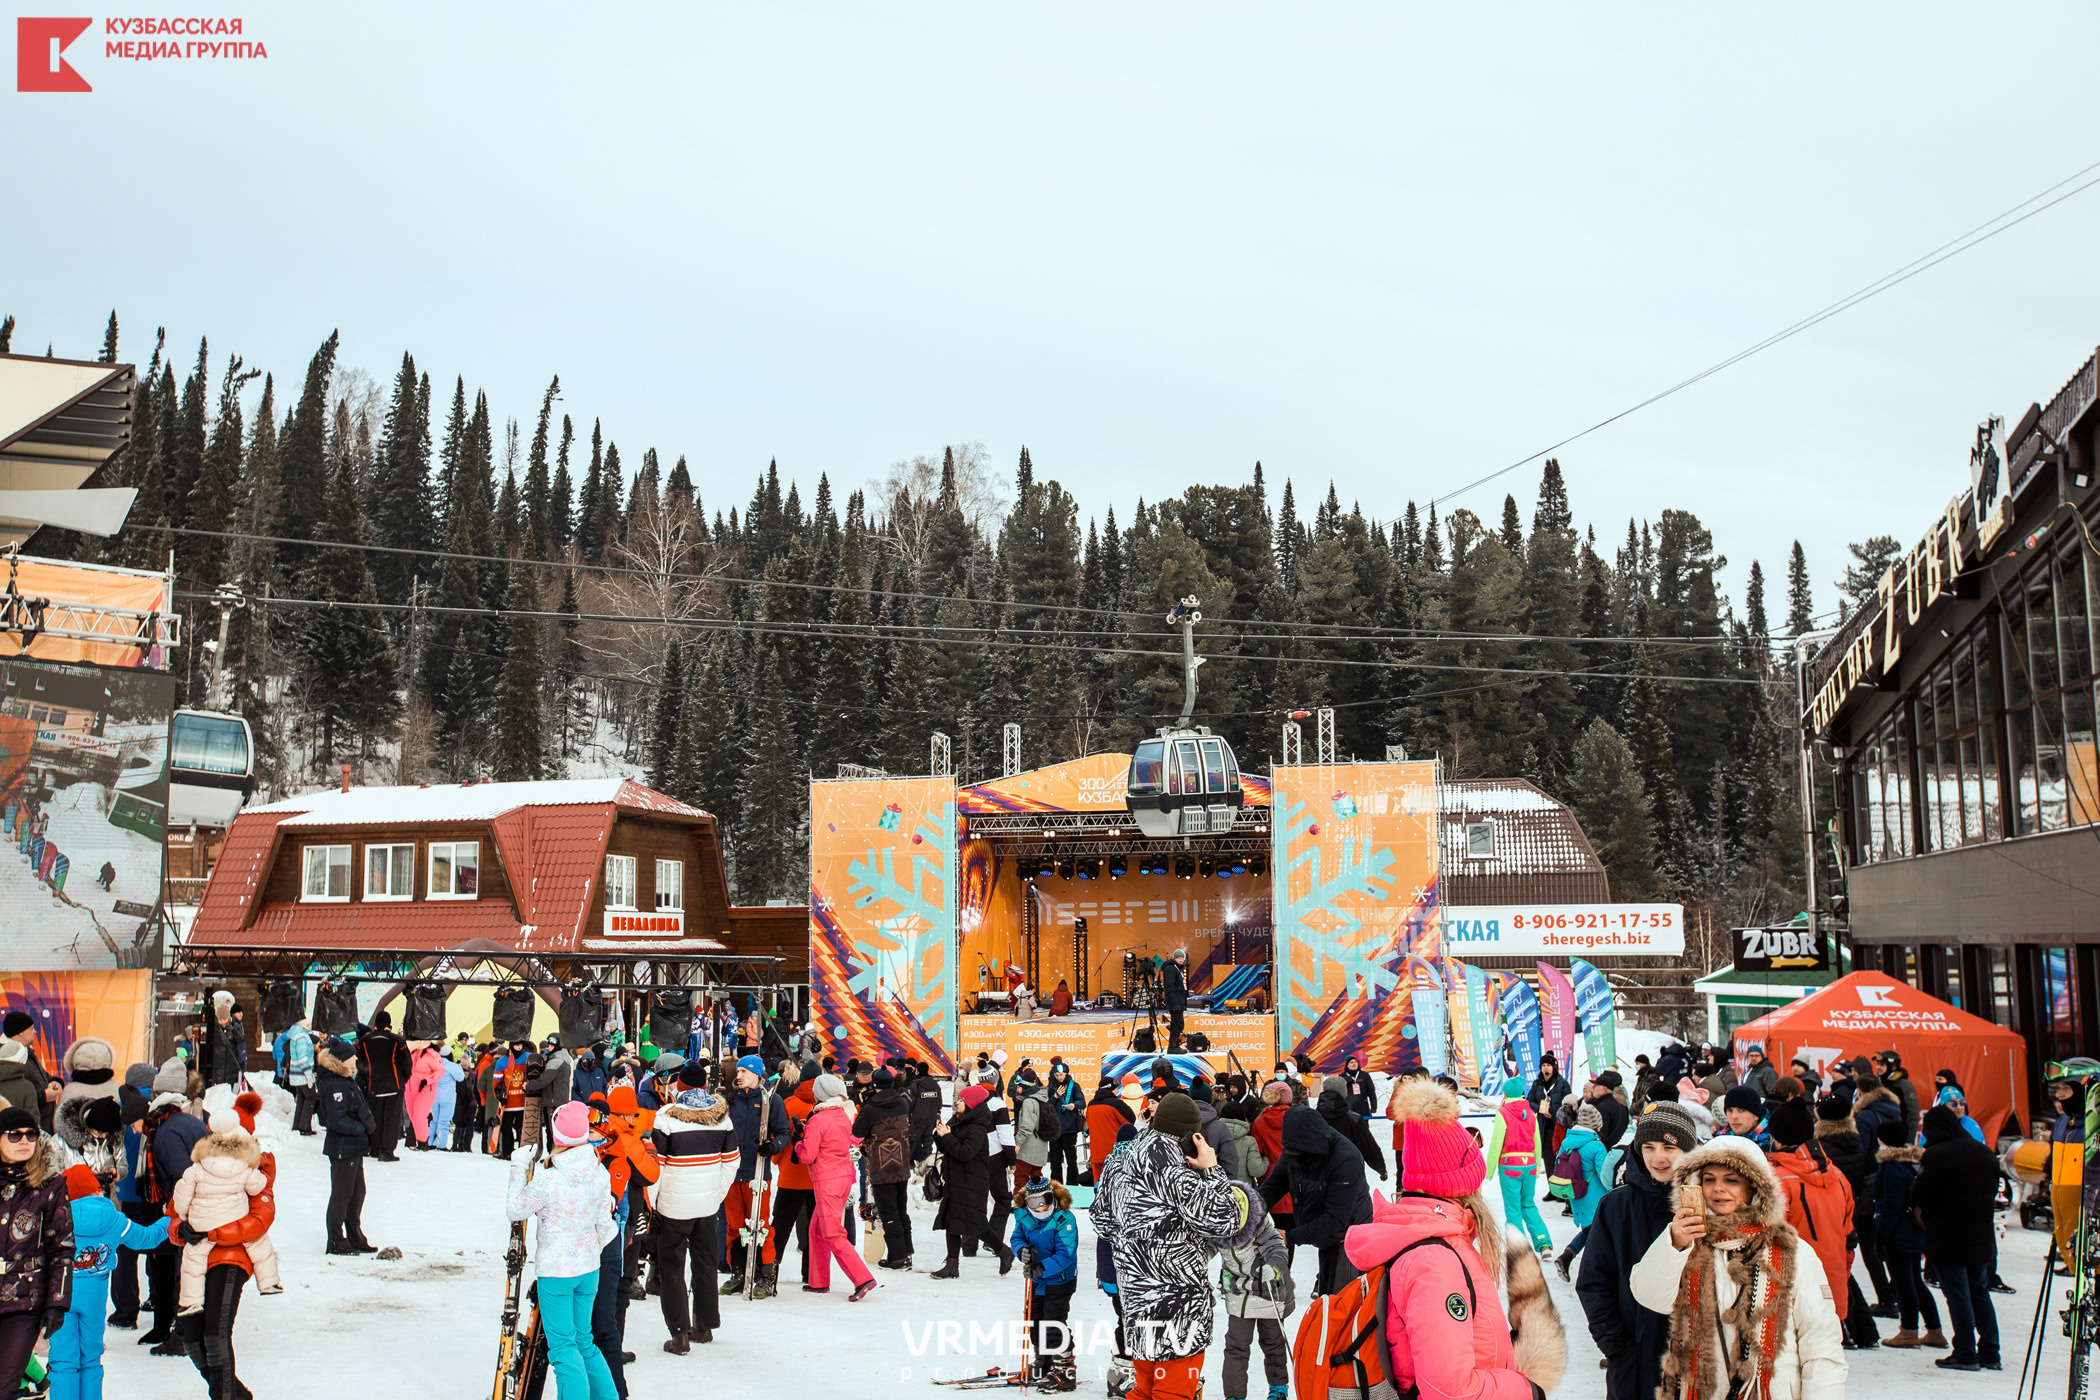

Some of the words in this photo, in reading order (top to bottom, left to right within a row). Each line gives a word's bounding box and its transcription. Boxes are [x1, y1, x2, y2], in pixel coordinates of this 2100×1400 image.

[1812, 660, 1847, 735] GRILL
[1847, 628, 1873, 691] BAR
[1878, 495, 1964, 676] ZUBR
[1078, 777, 1105, 790] 300
[1513, 912, 1673, 930] 8-906-921-17-55
[1542, 931, 1651, 948] sheregesh.biz
[1742, 929, 1820, 959] ZUBR
[1829, 1009, 1946, 1021] КУЗБАССКАЯ
[1822, 1019, 1886, 1032] МЕДИА
[1888, 1019, 1962, 1032] ГРУППА
